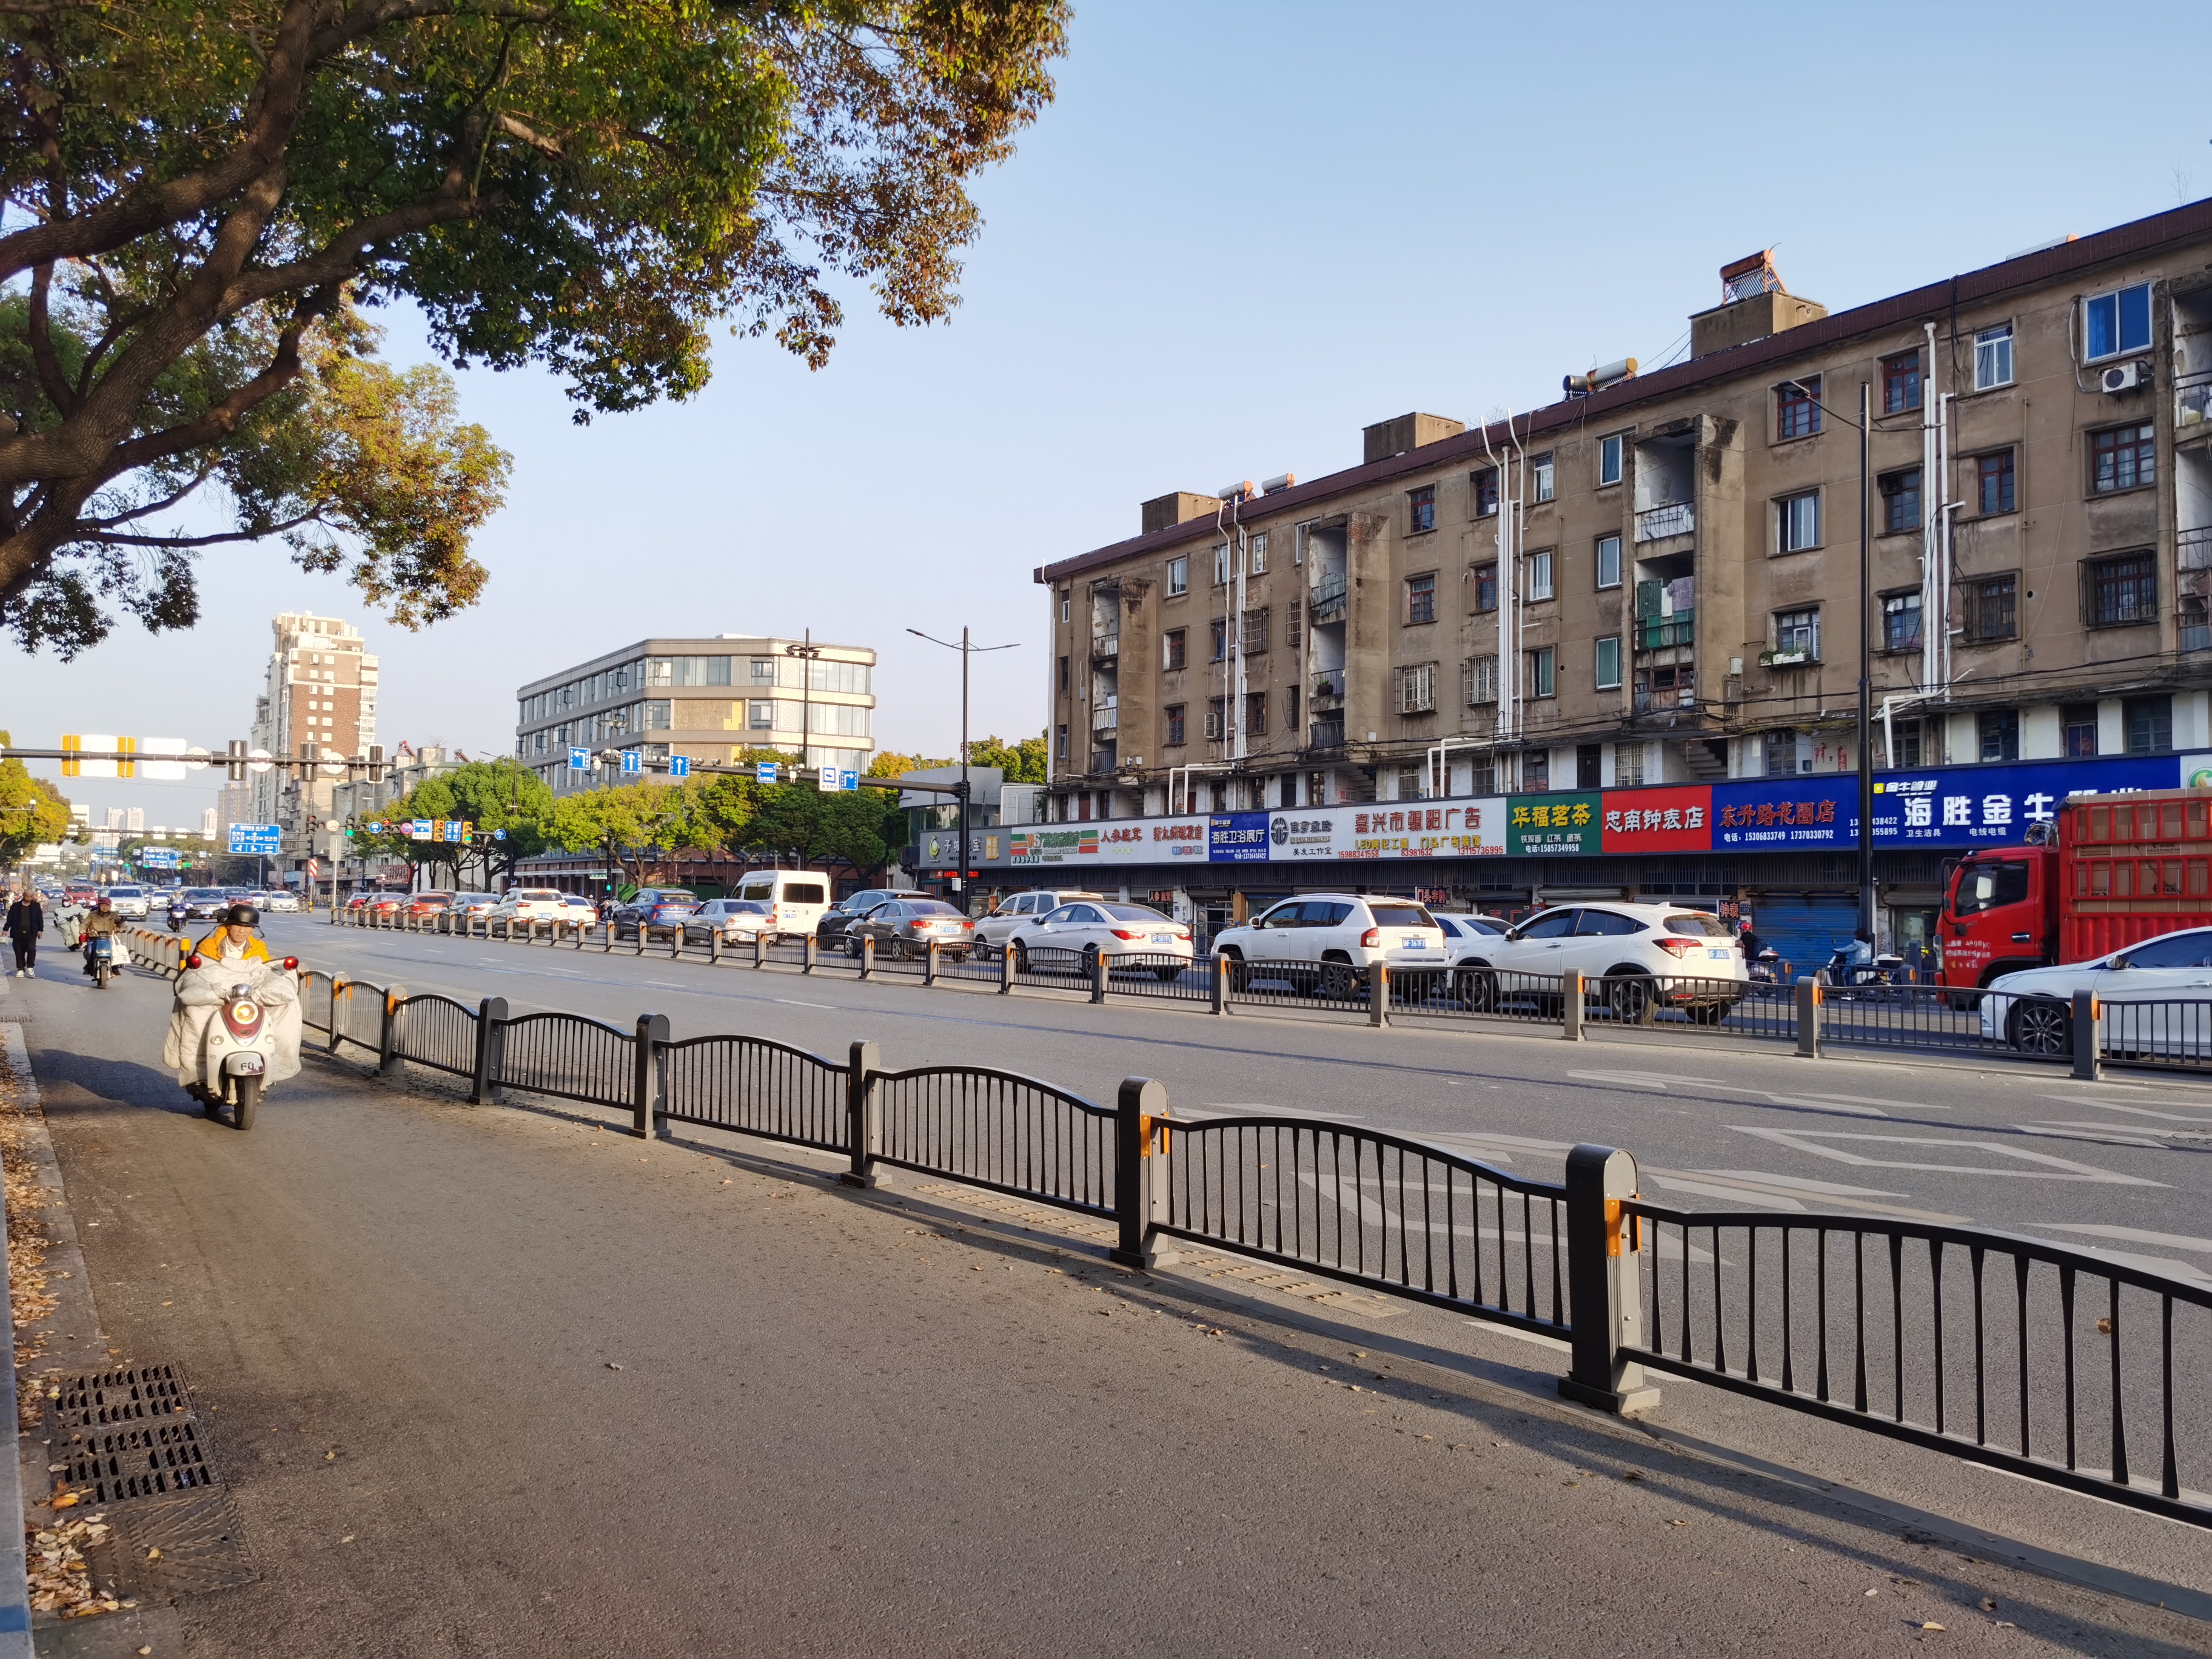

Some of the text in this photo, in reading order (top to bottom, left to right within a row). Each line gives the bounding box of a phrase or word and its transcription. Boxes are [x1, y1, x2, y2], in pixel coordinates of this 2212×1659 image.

[1885, 780, 1937, 792] 金牛管业
[1355, 807, 1481, 833] 嘉兴市朝阳广告
[1512, 803, 1592, 828] 华福茗茶
[1604, 806, 1705, 833] 忠南钟表店
[1719, 799, 1836, 827] 东升路花圈店
[1290, 820, 1333, 834] 佳剪乘除
[1849, 817, 1897, 826] 13438422
[1101, 827, 1142, 843] 人参鹿茸
[1153, 825, 1203, 841] 新九州理发店
[1212, 830, 1265, 844] 海胜卫浴展厅
[1521, 833, 1582, 843] 铁观音 红茶 绿茶
[1791, 830, 1834, 840] 17370330792
[1849, 828, 1897, 836] 13355895
[1906, 828, 1941, 837] 卫生洁具
[1969, 827, 2006, 836] 电线电缆
[945, 838, 981, 853] 子城宝
[1355, 835, 1481, 850] LED亮化工程 门头广告装饰
[1293, 847, 1332, 856] 美发工作室
[1338, 850, 1379, 859] 15988341558
[1458, 846, 1503, 855] 13115736995
[1720, 902, 1739, 918] 钟表
